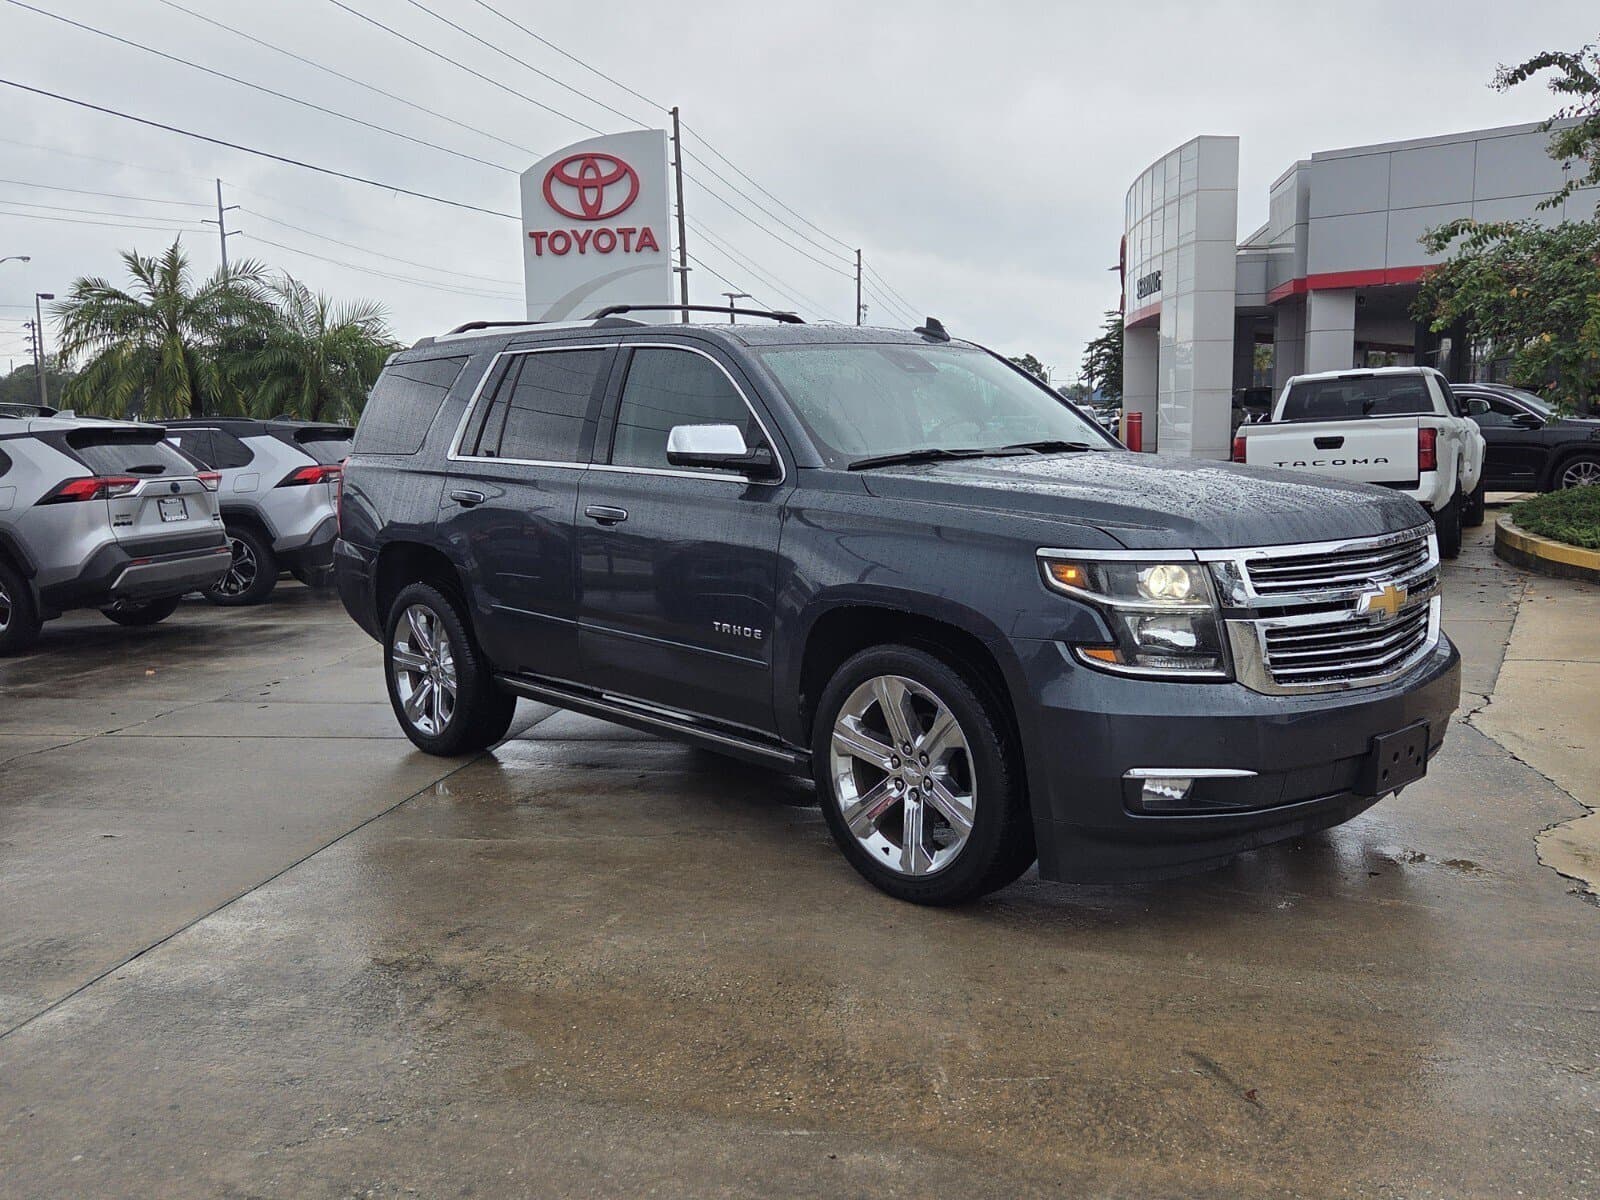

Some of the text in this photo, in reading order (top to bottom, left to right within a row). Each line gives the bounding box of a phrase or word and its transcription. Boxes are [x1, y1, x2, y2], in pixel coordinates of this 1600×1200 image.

[528, 227, 659, 256] TOYOTA
[1273, 457, 1389, 468] TACOMA
[712, 621, 763, 640] TAHOE
